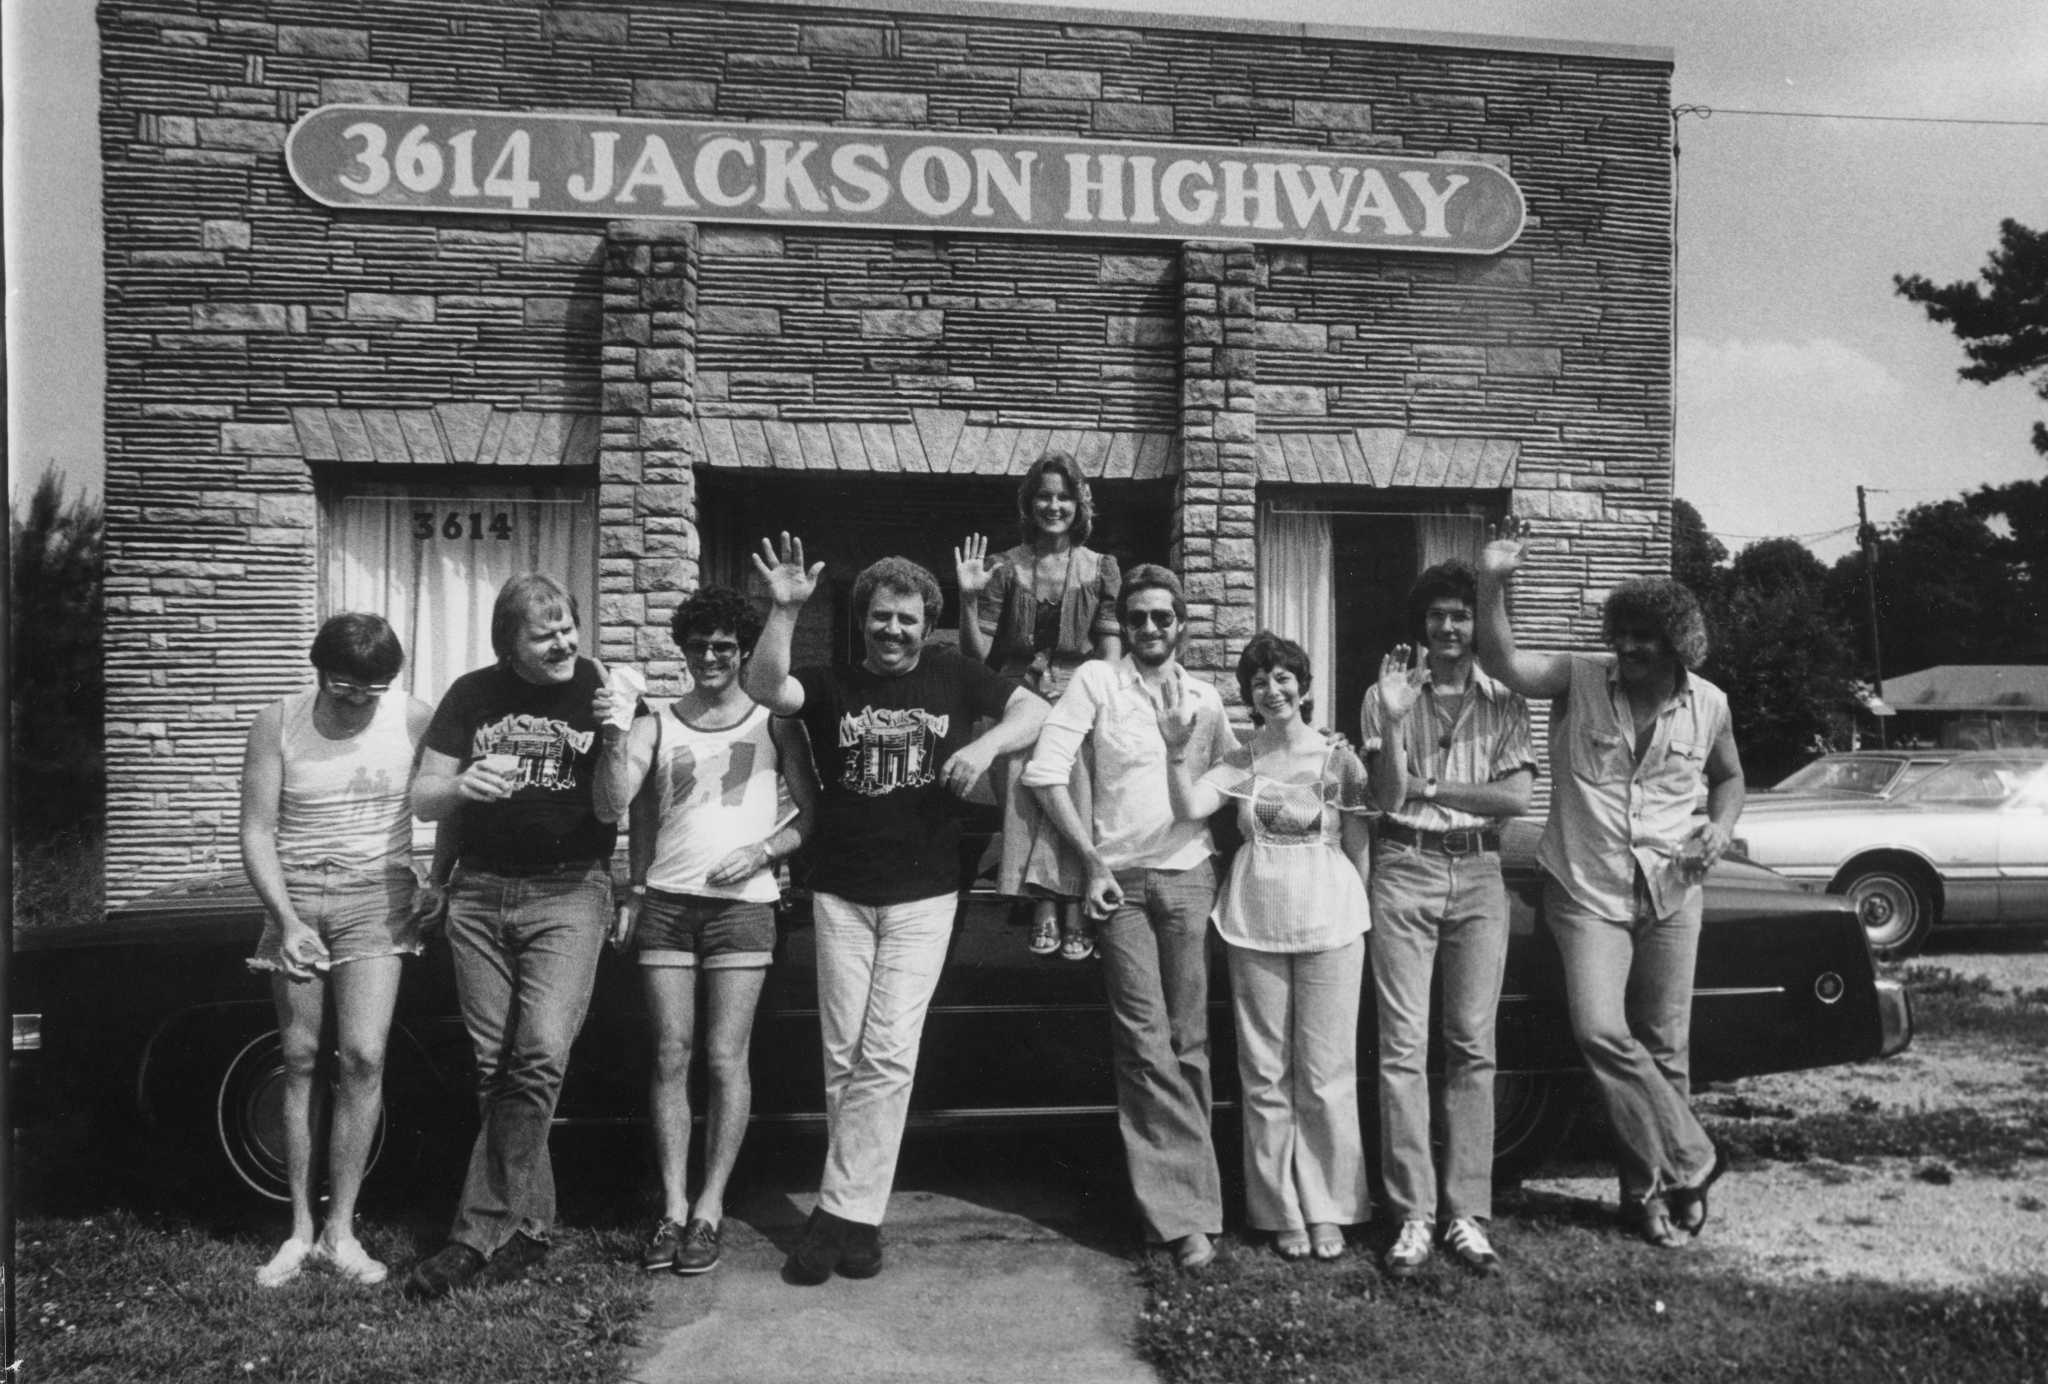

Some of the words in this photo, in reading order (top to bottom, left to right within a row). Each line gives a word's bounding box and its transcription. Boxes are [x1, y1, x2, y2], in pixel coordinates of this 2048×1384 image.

[338, 122, 540, 209] 3614
[566, 130, 1038, 222] JACKSON
[1064, 152, 1469, 238] HIGHWAY
[413, 511, 512, 540] 3614
